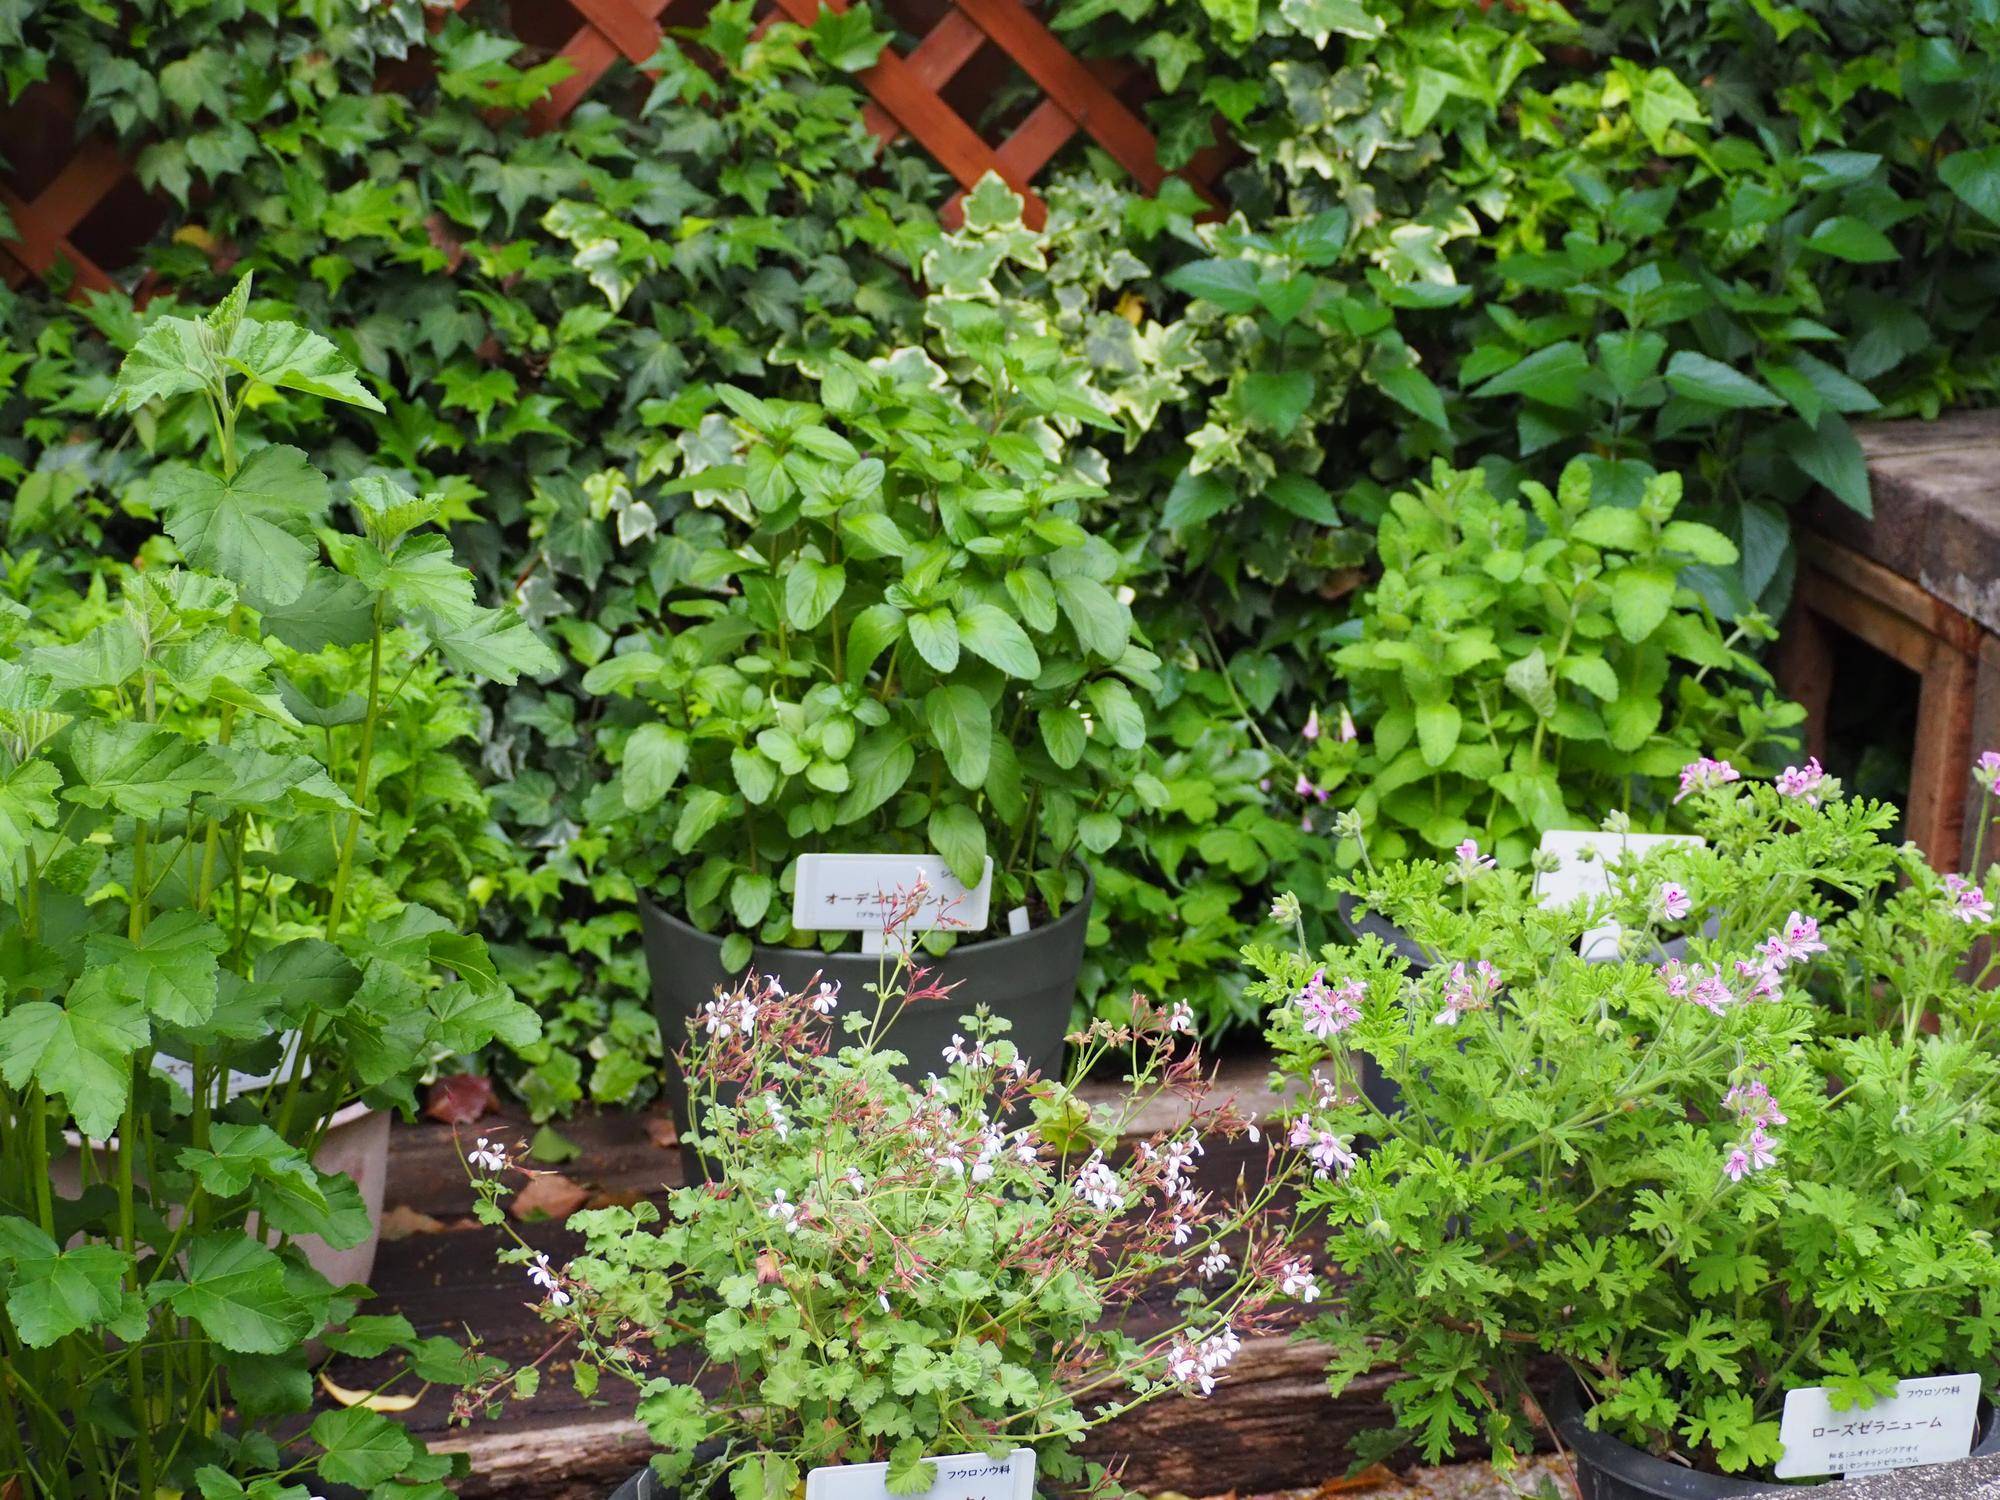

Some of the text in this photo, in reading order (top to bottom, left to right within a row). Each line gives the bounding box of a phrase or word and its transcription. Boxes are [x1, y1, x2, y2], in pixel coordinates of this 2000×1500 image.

[1906, 1386, 1960, 1398] フウロソウ科
[1812, 1416, 1942, 1438] ローズゼラニューム
[947, 1464, 1010, 1480] フウロソウ科
